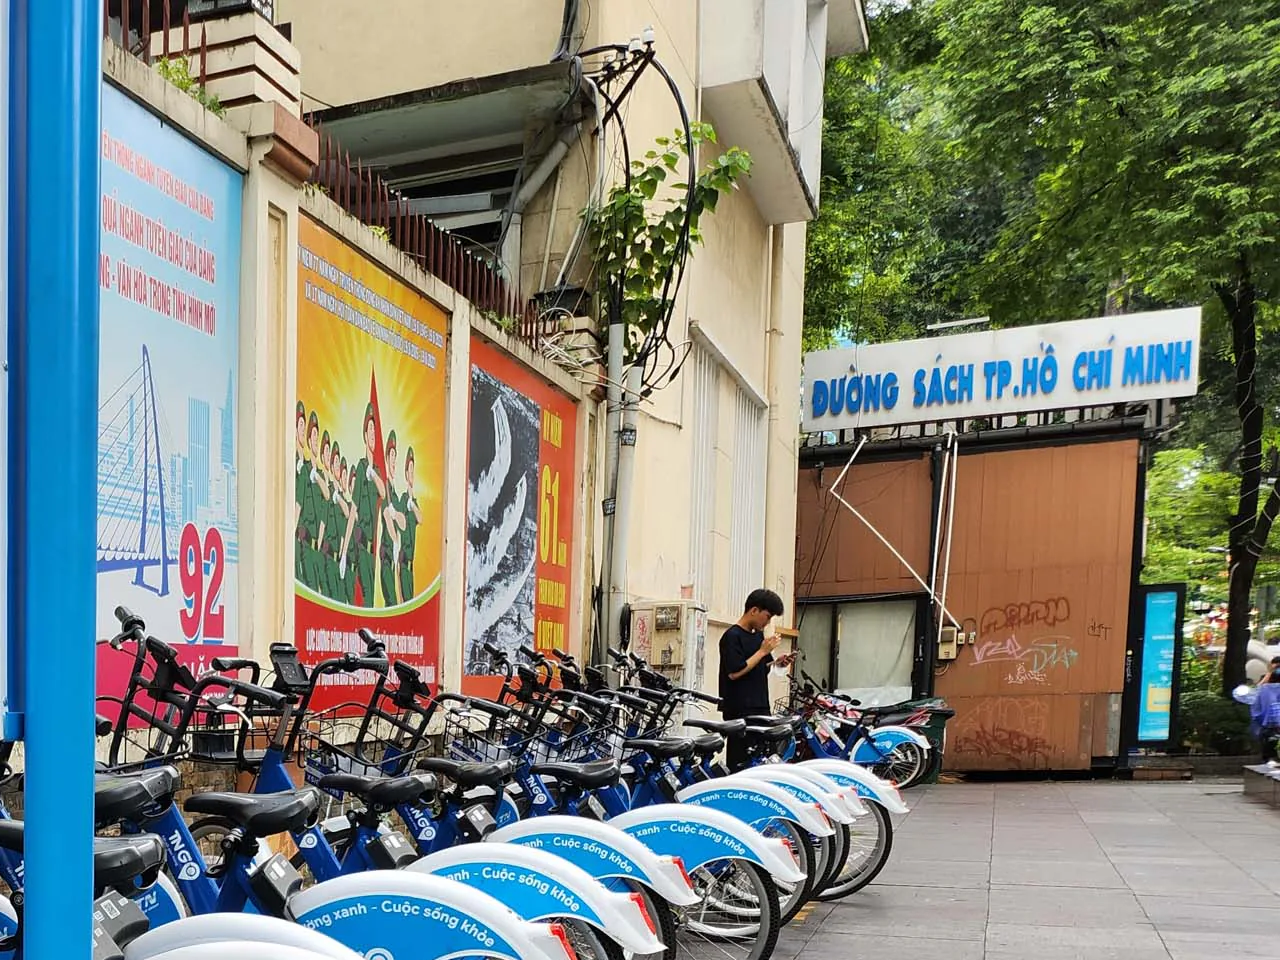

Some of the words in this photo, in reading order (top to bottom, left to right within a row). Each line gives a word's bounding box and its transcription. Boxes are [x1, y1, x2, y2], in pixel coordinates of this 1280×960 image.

[812, 364, 900, 418] ĐƯỜNG
[913, 354, 974, 407] SÁCH
[1073, 334, 1116, 391] CHÍ
[1122, 340, 1193, 387] MINH
[540, 464, 560, 565] 61
[179, 522, 225, 644] 92
[168, 829, 200, 881] TNGO
[553, 837, 580, 849] Cuộc
[636, 825, 660, 837] xanh
[670, 824, 697, 835] Cuộc
[482, 867, 516, 881] Cuộc
[519, 873, 549, 894] sống
[550, 885, 580, 912] khỏe
[334, 903, 367, 920] xanh
[381, 900, 420, 917] Cuộc
[423, 906, 459, 928] sống
[460, 919, 495, 947] khỏe
